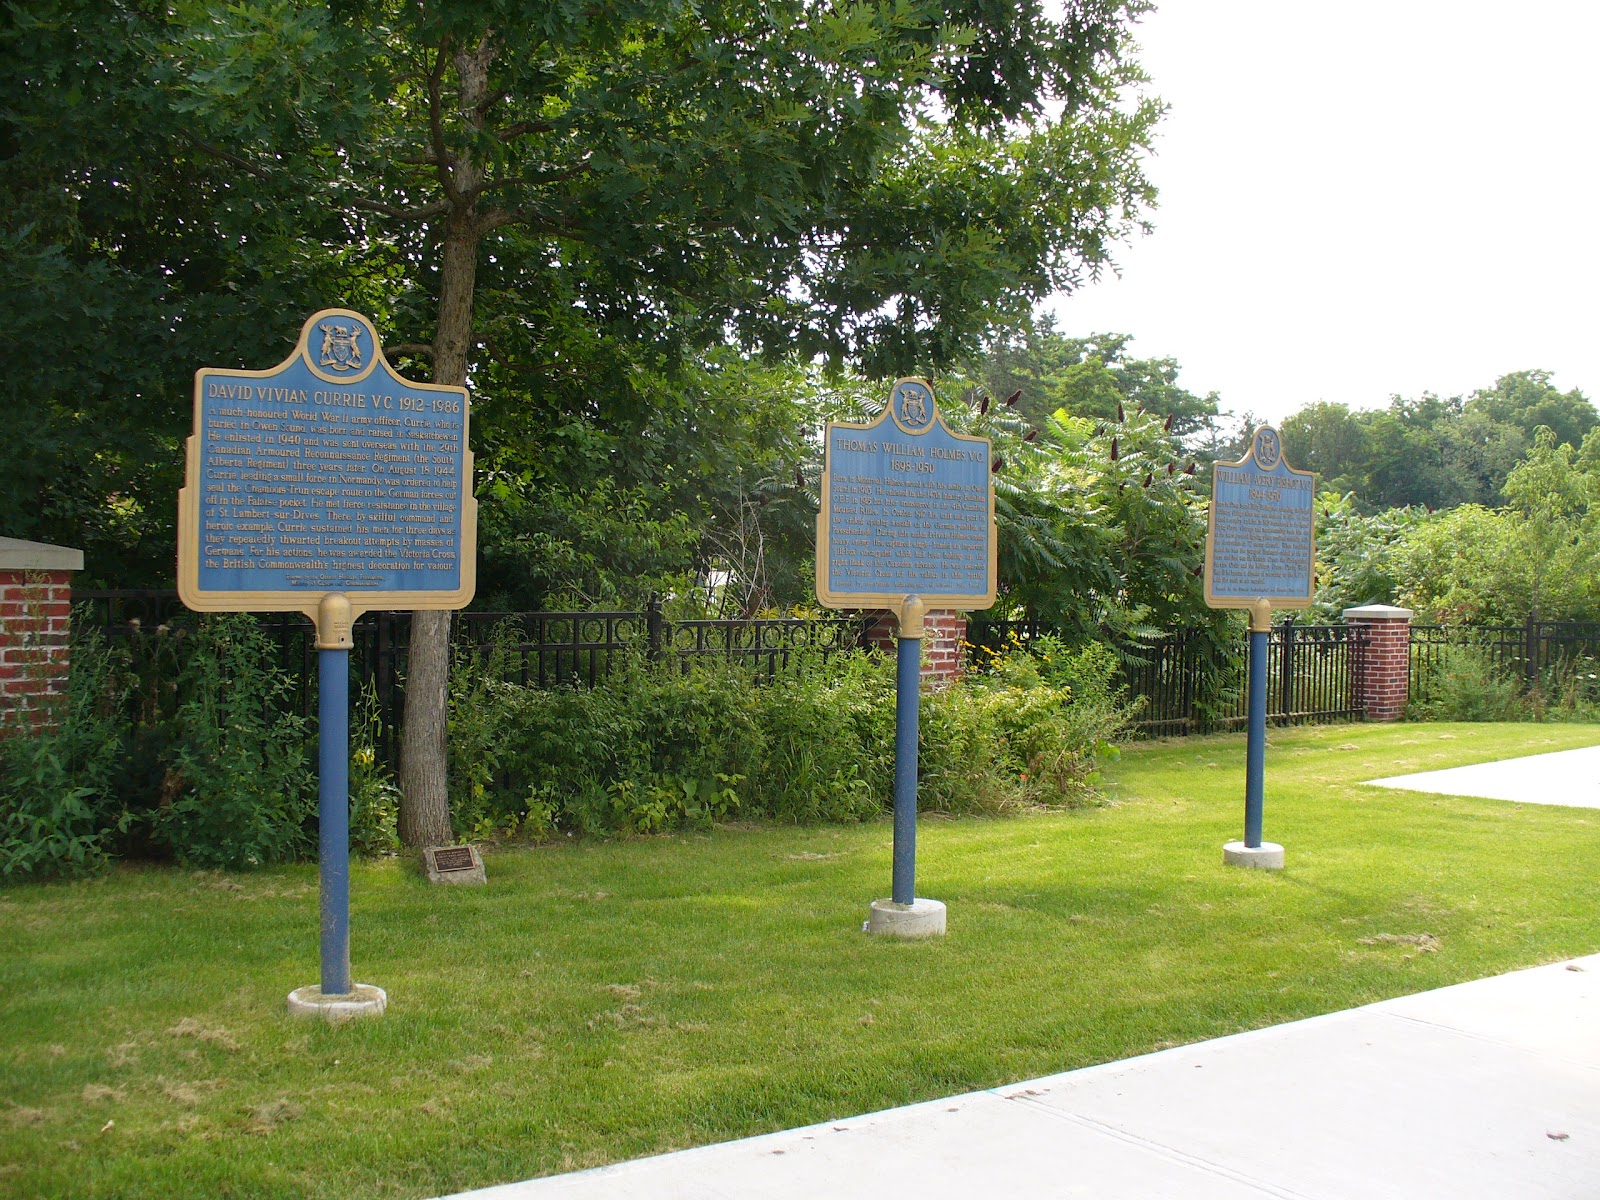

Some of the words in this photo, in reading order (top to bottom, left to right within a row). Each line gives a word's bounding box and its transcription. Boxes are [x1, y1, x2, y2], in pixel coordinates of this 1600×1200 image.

[208, 384, 253, 401] DAVID
[256, 387, 308, 404] VIVIAN
[313, 391, 367, 408] CURRIE
[398, 396, 461, 414] 1912-1986
[207, 418, 237, 429] buried
[240, 421, 250, 430] in
[252, 420, 278, 431] Owen
[309, 426, 327, 434] was
[329, 424, 348, 435] born
[349, 426, 365, 436] and
[368, 427, 394, 437] raised
[291, 410, 318, 421] World
[321, 412, 340, 422] War
[351, 416, 372, 427] army
[374, 415, 403, 427] officer,
[434, 419, 450, 429] who
[451, 421, 460, 429] is
[207, 431, 221, 441] He
[224, 432, 261, 443] enlisted
[265, 435, 274, 444] in
[277, 434, 301, 445] 1940
[303, 436, 320, 446] and
[322, 439, 339, 447] was
[342, 439, 360, 448] sent
[361, 441, 397, 450] overseas
[399, 441, 420, 451] with
[422, 442, 436, 451] the
[438, 443, 459, 452] 29th
[837, 439, 877, 452] THOMAS
[882, 443, 924, 457] WILLIAM
[930, 447, 965, 460] HOLMES
[207, 443, 251, 455] Canadian
[255, 446, 300, 457] Armoured
[304, 448, 371, 460] Reconnaissance
[374, 451, 410, 464] Regiment
[413, 453, 430, 465] (the
[432, 454, 454, 464] South
[206, 456, 243, 467] Alberta
[246, 458, 290, 472] Regiment)
[293, 460, 317, 470] three
[318, 463, 343, 474] years
[371, 463, 385, 473] On
[388, 464, 417, 476] August
[891, 459, 935, 474] 1898-1950
[240, 470, 272, 483] leading
[280, 472, 304, 482] small
[306, 473, 327, 483] force
[328, 475, 337, 483] in
[401, 476, 432, 487] ordered
[433, 479, 441, 487] to
[441, 478, 458, 490] help
[1217, 471, 1250, 485] WILLIAM
[1254, 475, 1275, 486] AVERY
[206, 482, 225, 492] seal
[227, 482, 242, 492] the
[311, 488, 340, 498] escape
[341, 487, 364, 496] route
[364, 488, 373, 496] to
[374, 487, 387, 497] the
[388, 488, 419, 498] German
[421, 489, 444, 499] forces
[205, 495, 218, 505] off
[219, 496, 229, 505] in
[230, 496, 245, 506] the
[247, 496, 277, 506] Falaise
[310, 498, 325, 508] He
[325, 499, 340, 508] met
[342, 499, 366, 509] fierce
[367, 501, 408, 510] resistance
[409, 502, 417, 510] in
[419, 501, 431, 510] the
[432, 502, 457, 513] village
[205, 508, 215, 517] of
[356, 511, 367, 523] by
[368, 512, 396, 521] skilful
[399, 512, 436, 522] command
[439, 513, 454, 523] and
[205, 521, 234, 531] heroic
[277, 522, 308, 532] Currie
[310, 523, 353, 533] sustained
[356, 524, 370, 534] his
[392, 525, 403, 534] for
[405, 525, 427, 535] three
[428, 526, 446, 537] days
[204, 534, 226, 546] they
[228, 534, 276, 546] repeatedly
[279, 535, 321, 545] thwarted
[324, 535, 362, 545] breakout
[364, 537, 400, 548] attempts
[402, 537, 414, 548] by
[445, 537, 455, 546] of
[249, 547, 264, 556] For
[266, 547, 280, 556] his
[317, 547, 328, 557] he
[348, 548, 383, 557] awarded
[384, 548, 398, 557] the
[398, 548, 430, 558] Victoria
[205, 559, 220, 568] the
[222, 559, 256, 569] British
[258, 559, 330, 569] Commonwealth's
[332, 560, 365, 571] highest
[368, 560, 411, 569] decoration
[413, 560, 425, 569] for
